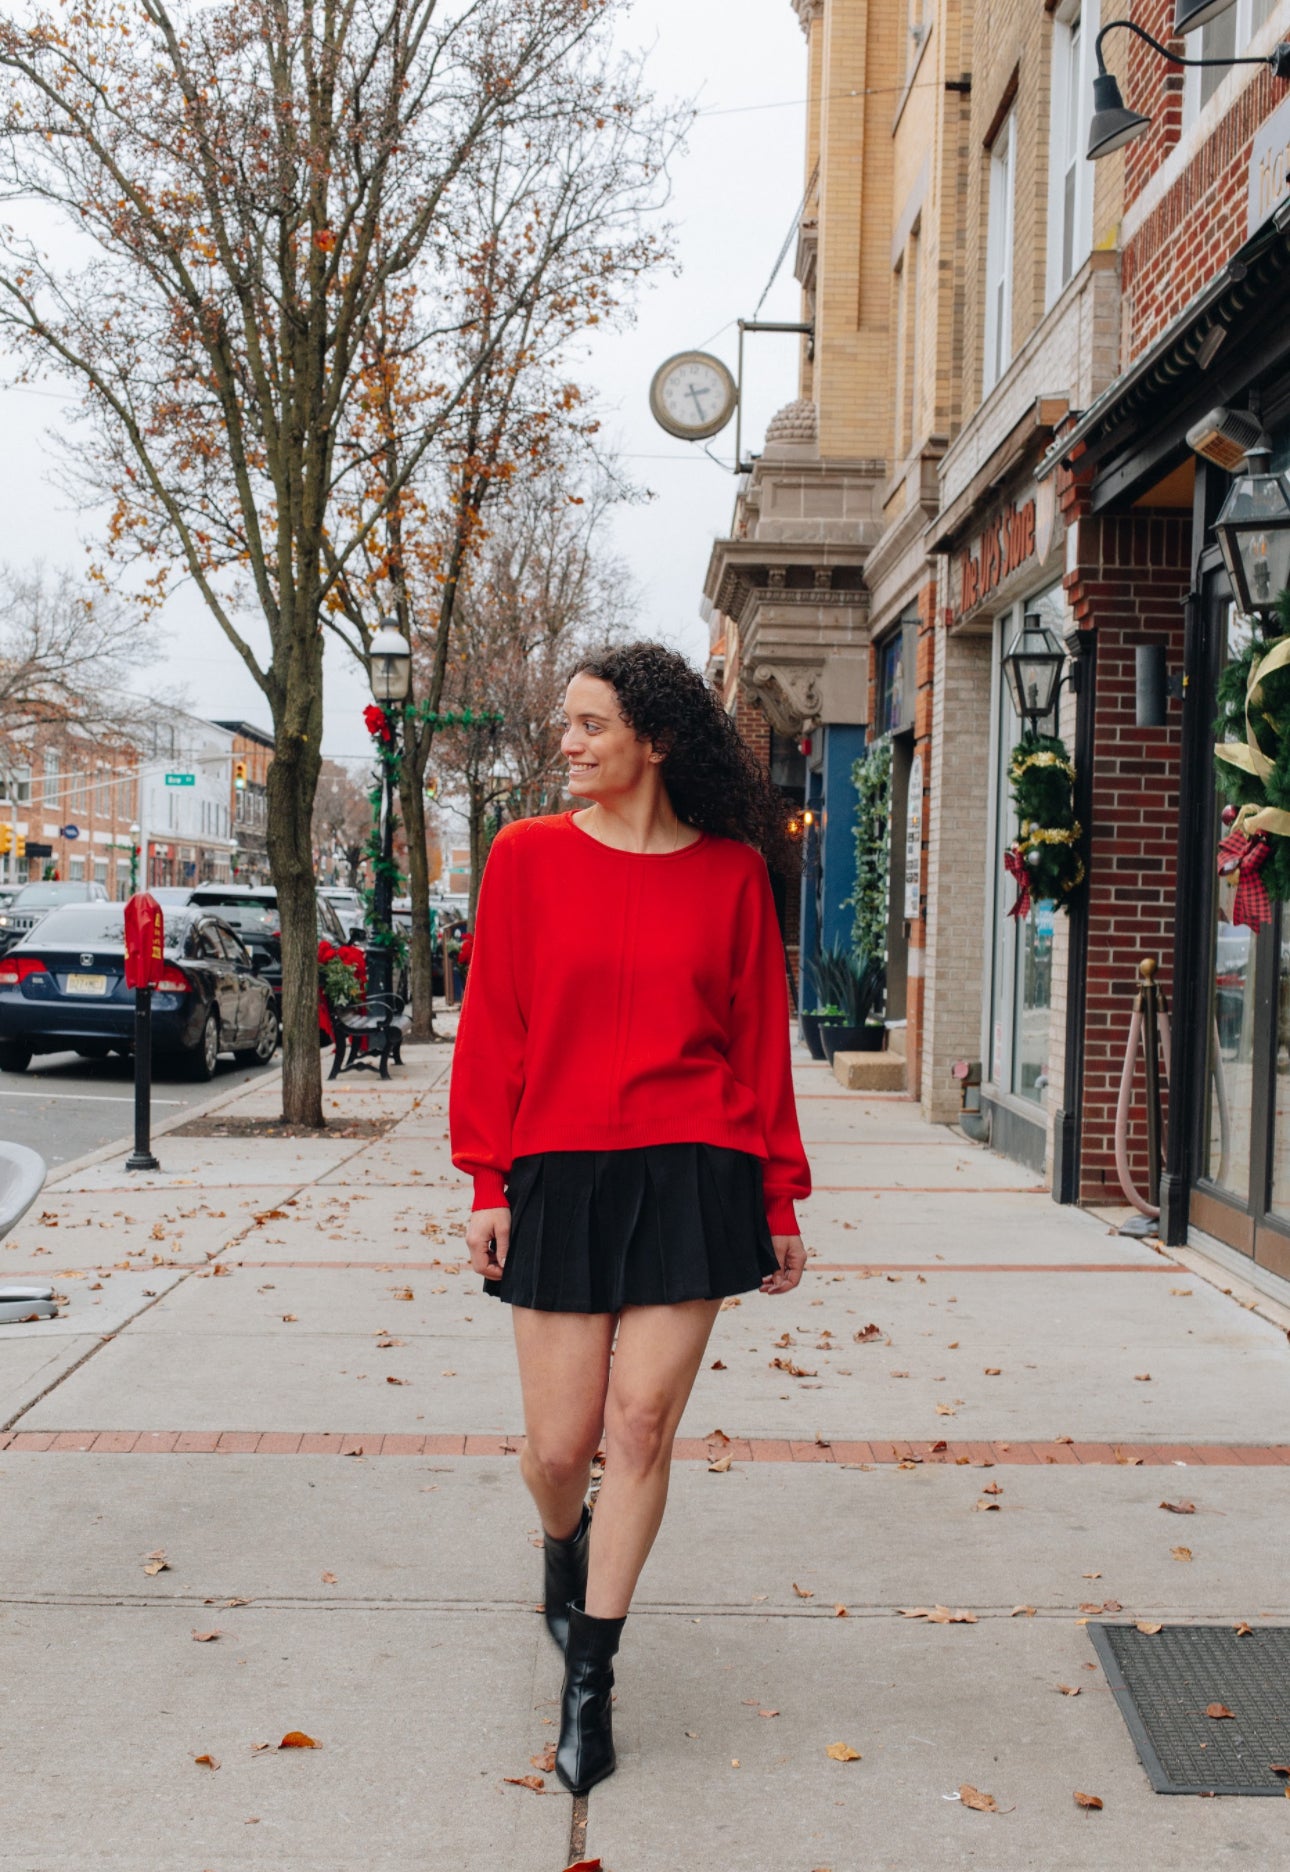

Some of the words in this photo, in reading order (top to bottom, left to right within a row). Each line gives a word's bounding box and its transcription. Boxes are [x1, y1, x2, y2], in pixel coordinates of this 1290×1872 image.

[961, 548, 979, 614] The
[980, 516, 1002, 598] UPS
[1003, 499, 1035, 577] Store
